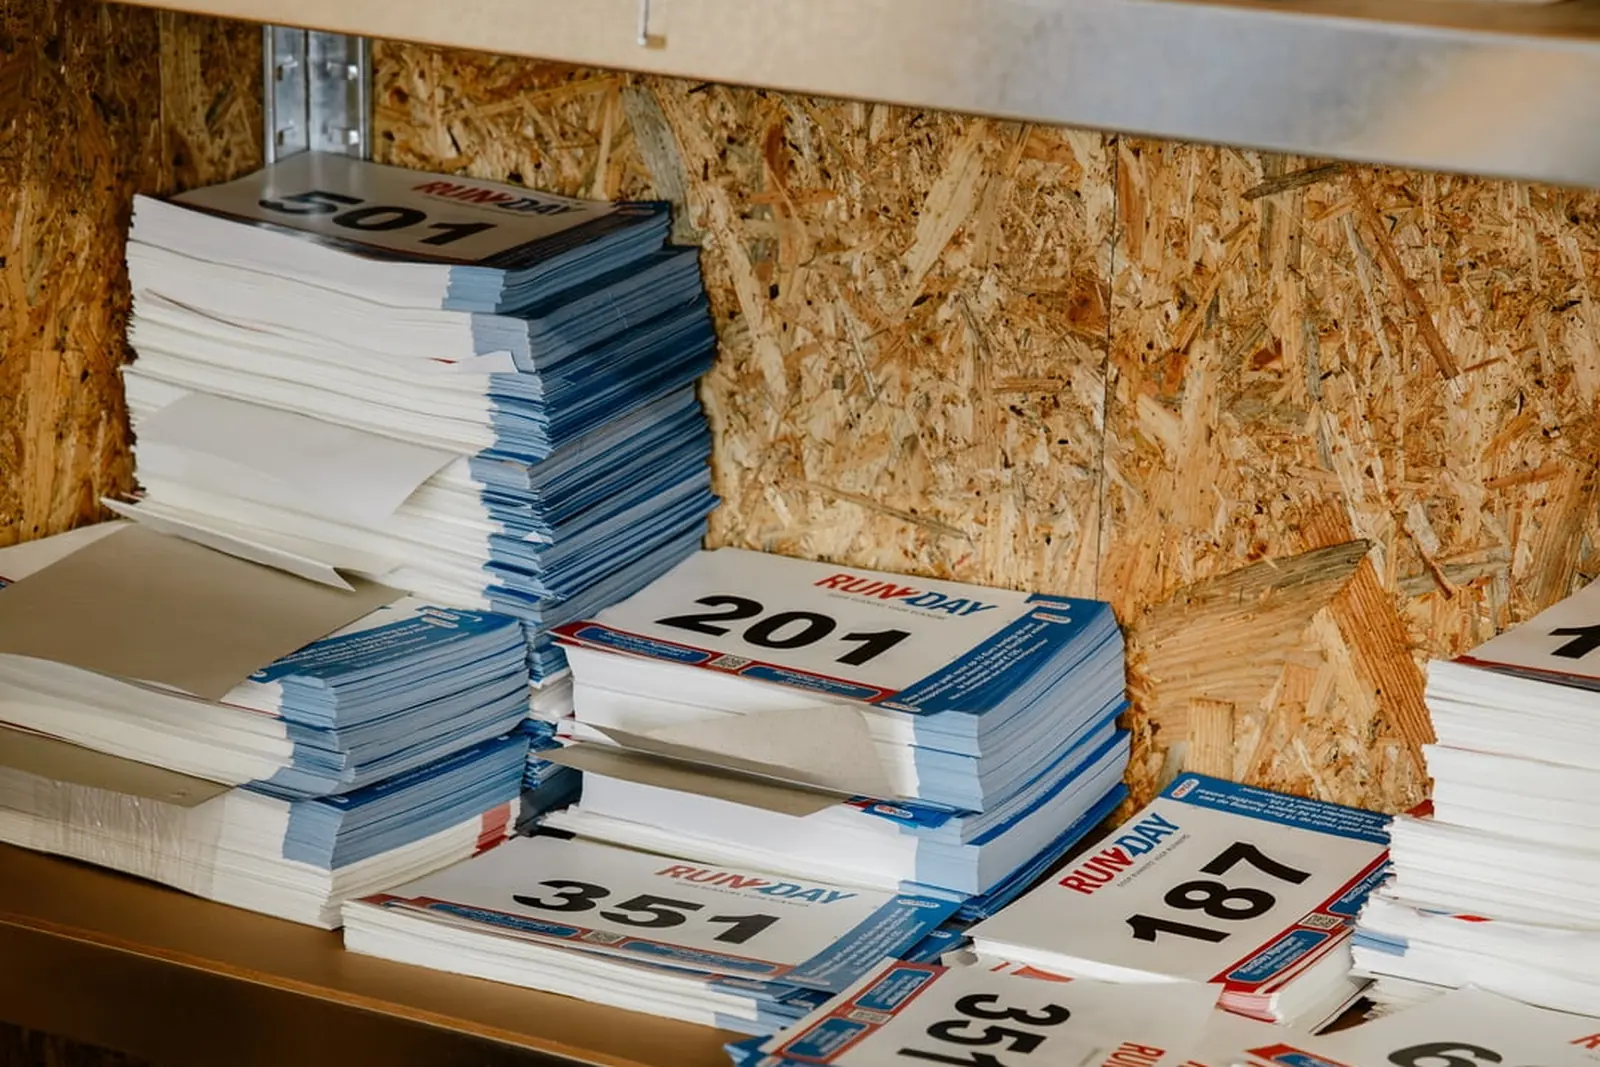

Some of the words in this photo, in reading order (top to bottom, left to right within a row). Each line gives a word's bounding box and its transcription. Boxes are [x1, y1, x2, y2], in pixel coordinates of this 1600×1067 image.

[258, 190, 498, 246] 501
[654, 595, 911, 667] 201
[512, 879, 780, 945] 351
[1125, 841, 1312, 943] 187
